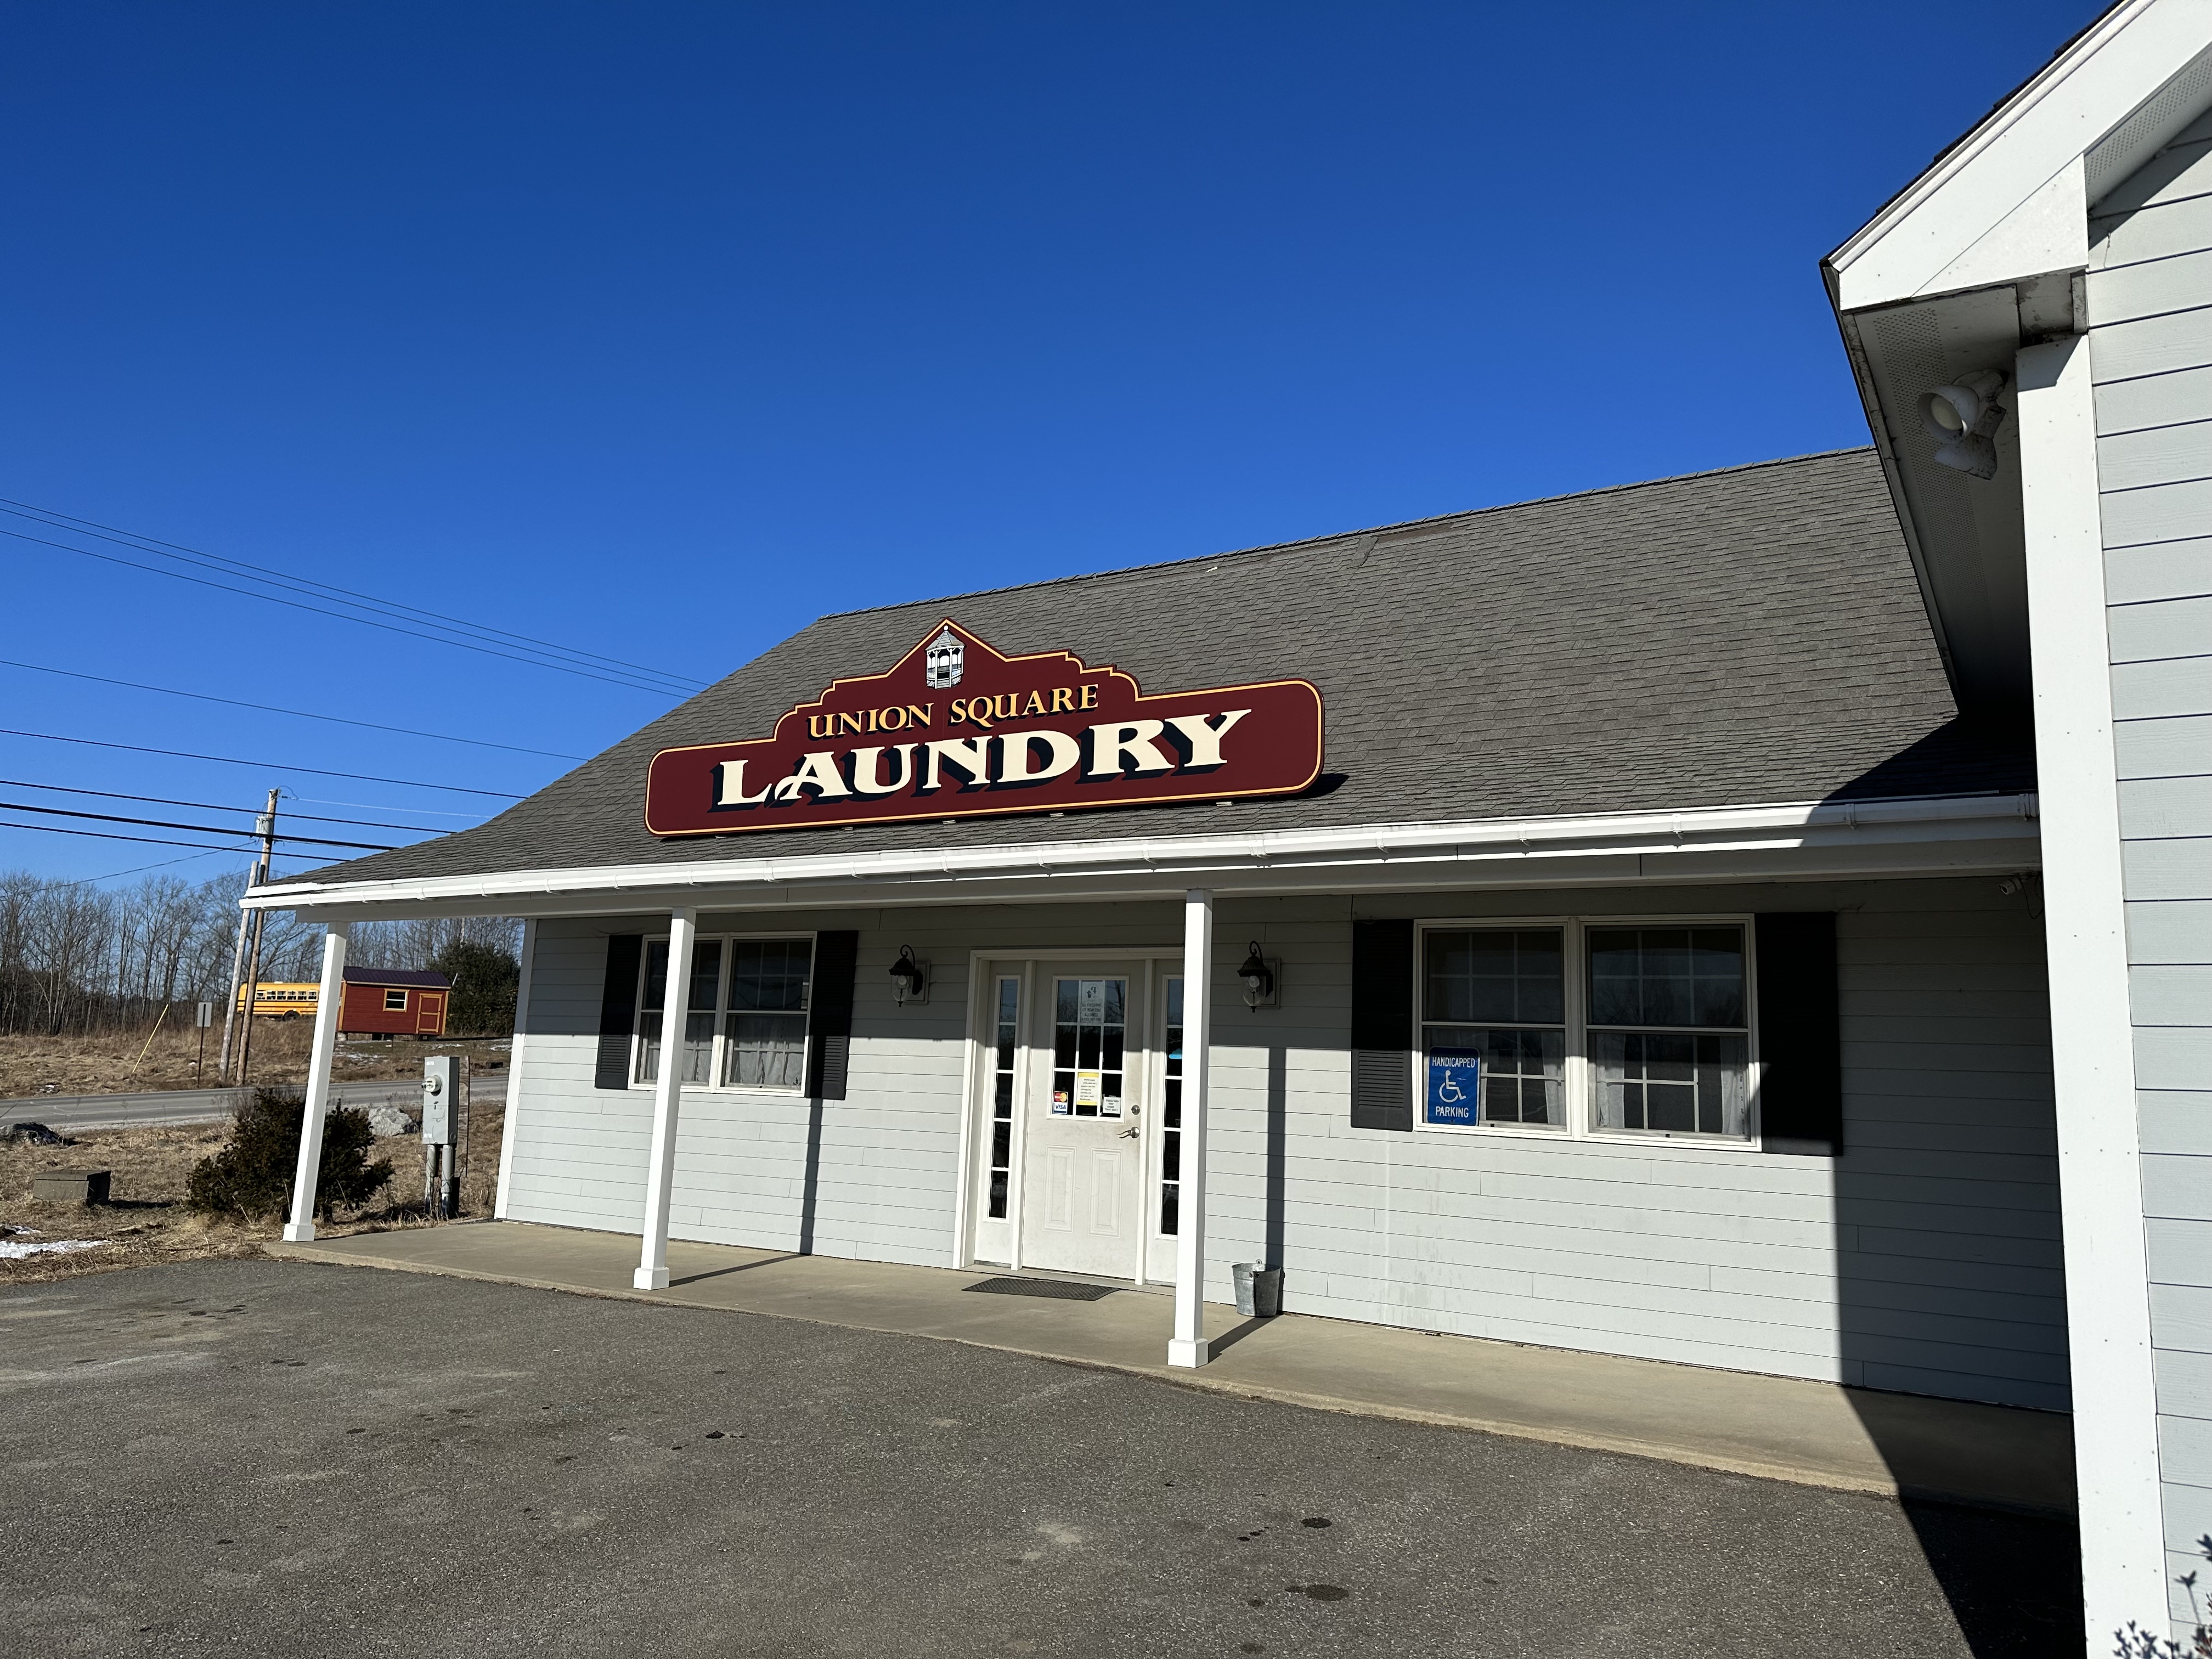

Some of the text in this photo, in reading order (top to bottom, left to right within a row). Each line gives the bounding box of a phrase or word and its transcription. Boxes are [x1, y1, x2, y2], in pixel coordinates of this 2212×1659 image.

[808, 684, 1098, 738] UNION SQUARE
[717, 709, 1252, 805] LAUNDRY
[1432, 1056, 1475, 1068] HANDICAPPED
[1435, 1106, 1469, 1118] PARKING
